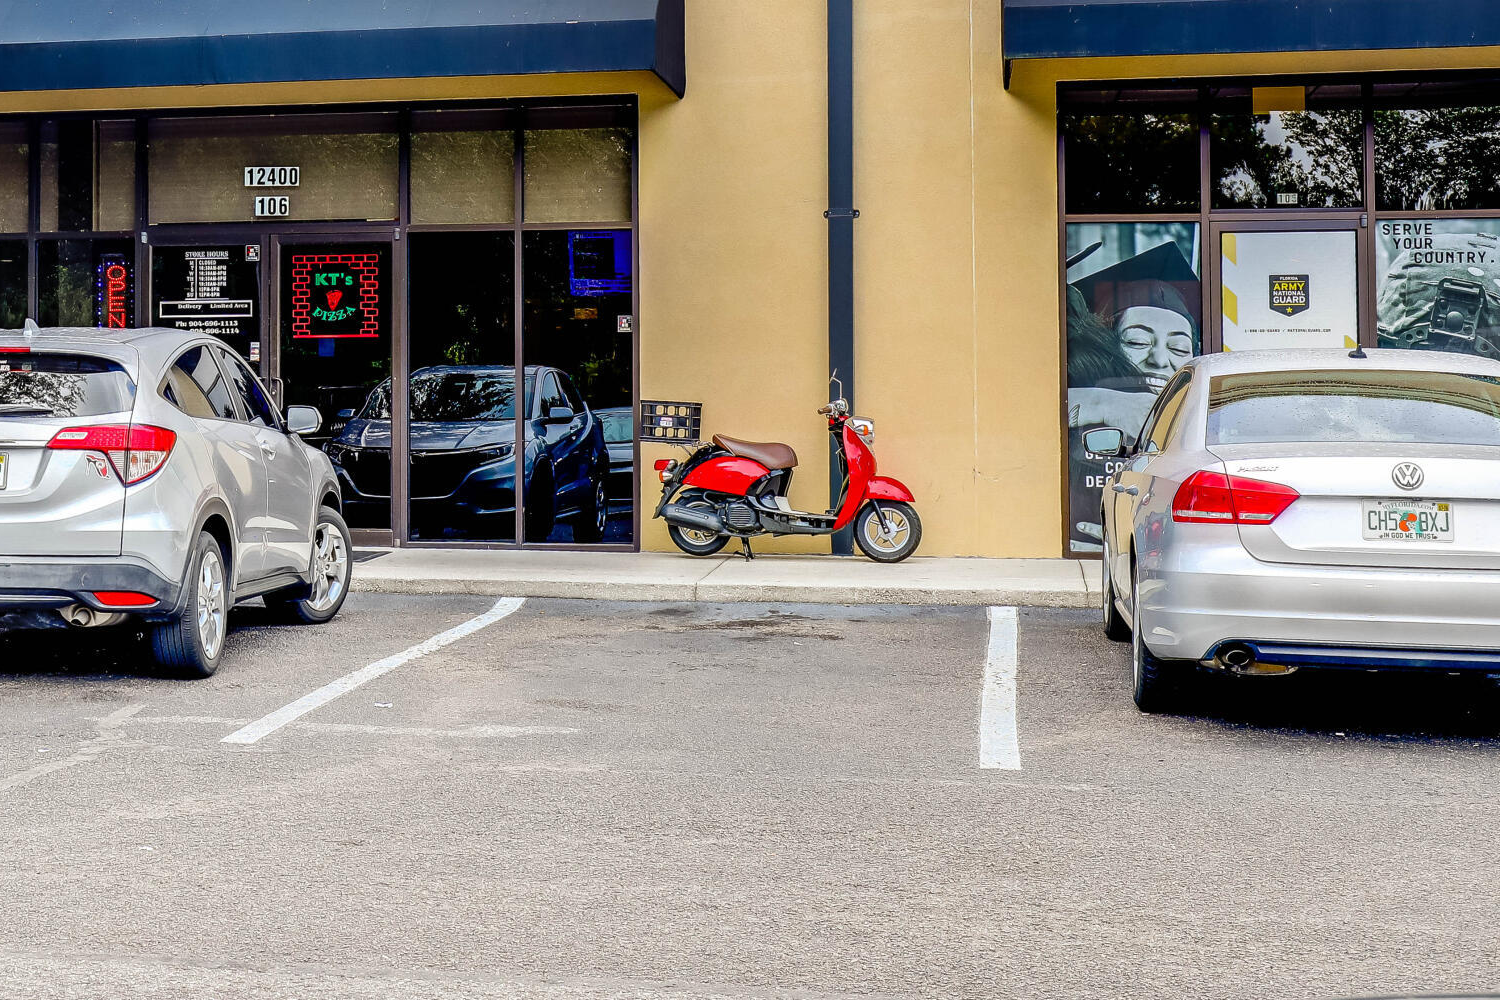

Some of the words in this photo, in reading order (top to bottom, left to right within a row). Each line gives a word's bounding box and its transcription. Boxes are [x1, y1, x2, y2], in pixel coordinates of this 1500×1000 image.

[247, 167, 298, 185] 12400
[1278, 194, 1297, 203] 105
[258, 197, 288, 215] 106
[1382, 223, 1433, 236] SERVE
[1393, 238, 1433, 250] YOUR
[1414, 251, 1495, 264] COUNTRY.
[315, 272, 353, 286] KT's
[1273, 282, 1305, 291] ARMY
[106, 264, 127, 329] OPEN
[1273, 296, 1306, 304] GUARD
[312, 306, 356, 321] PIZZA
[1415, 532, 1435, 540] TRUST
